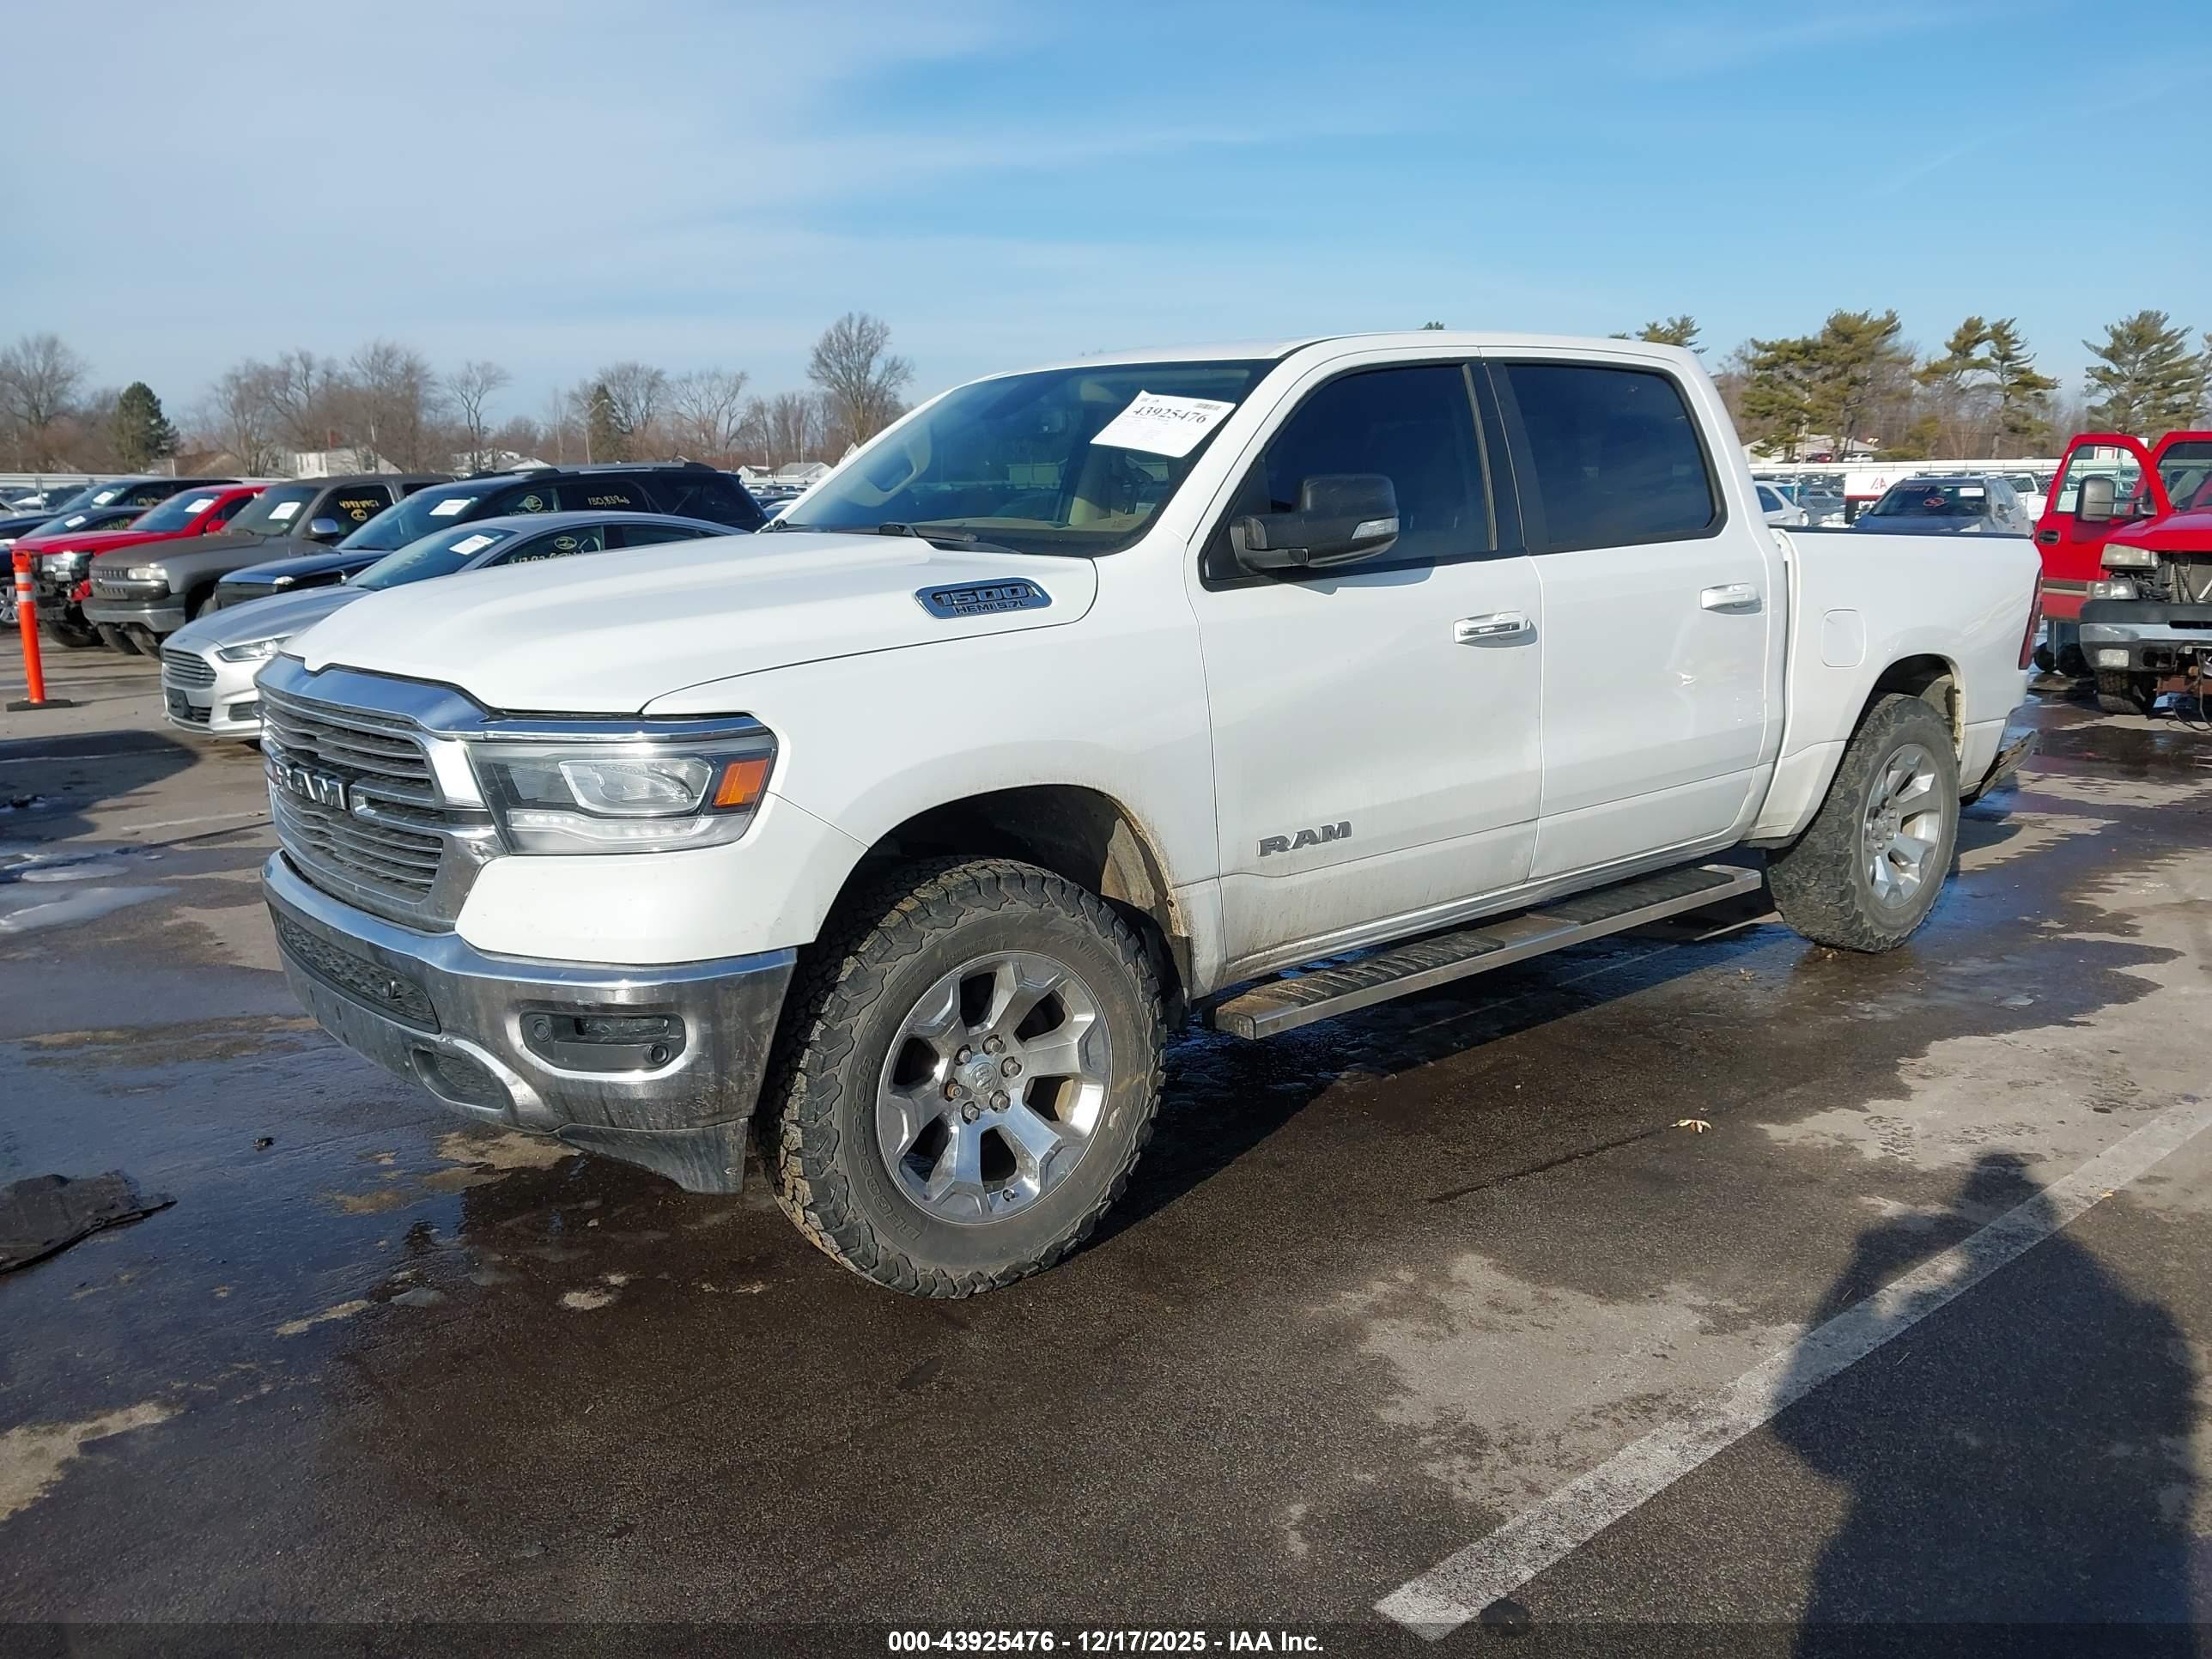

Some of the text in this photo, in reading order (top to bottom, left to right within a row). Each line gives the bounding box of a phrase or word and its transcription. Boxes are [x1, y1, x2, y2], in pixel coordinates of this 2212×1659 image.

[1133, 405, 1210, 424] 43925476
[936, 586, 1026, 606] 1500
[954, 599, 1030, 617] HEMI 5.7L
[1256, 820, 1353, 858] RAM
